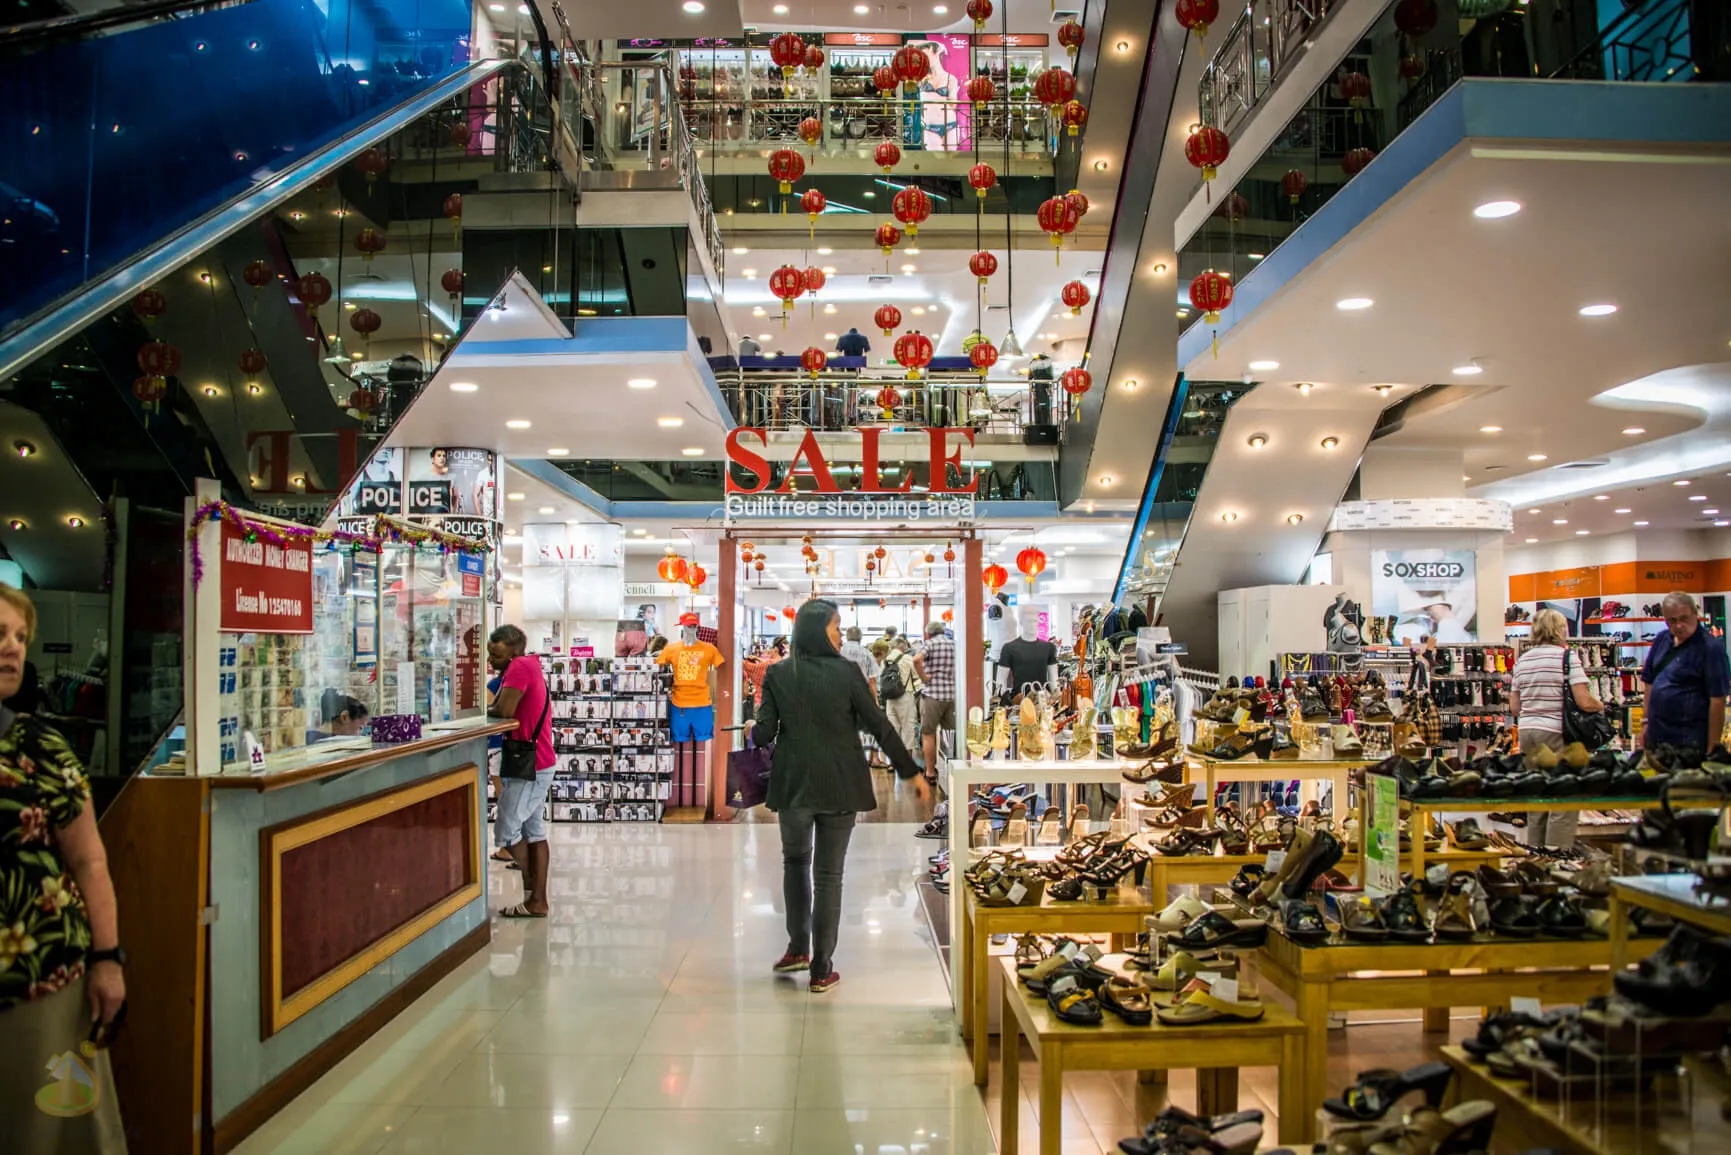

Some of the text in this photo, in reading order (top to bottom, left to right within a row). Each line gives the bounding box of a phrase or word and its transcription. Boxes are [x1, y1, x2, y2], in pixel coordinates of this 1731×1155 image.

[725, 425, 979, 495] SALE
[727, 495, 974, 520] Guilt free shopping area
[338, 521, 366, 535] OLICE
[445, 521, 484, 535] POLICE
[539, 544, 596, 560] SALE
[235, 586, 259, 613] License
